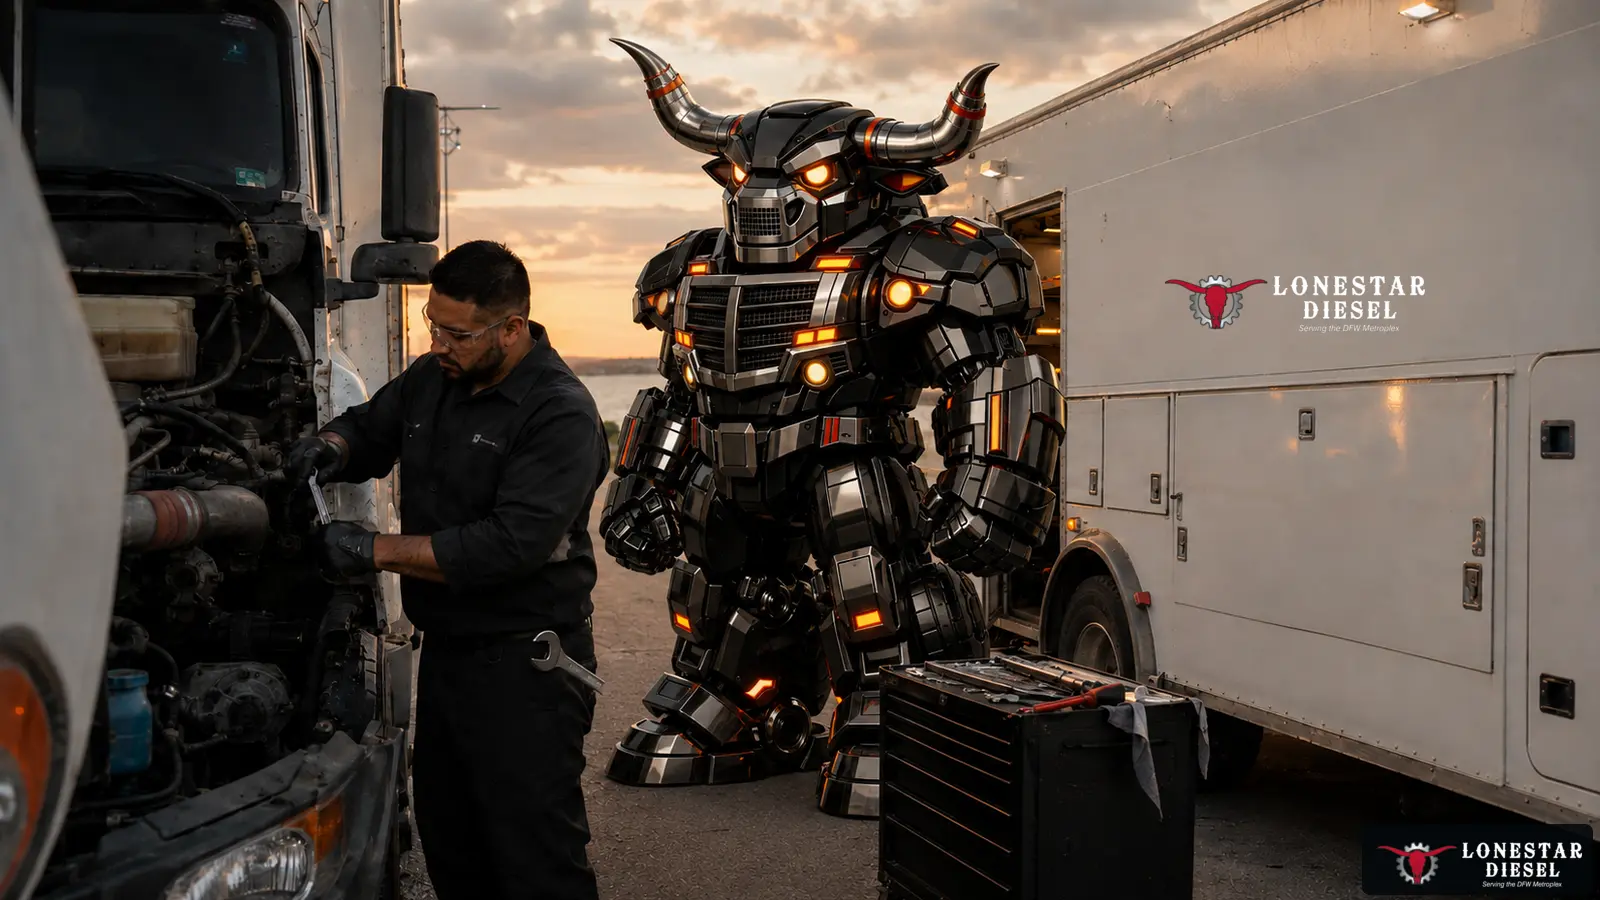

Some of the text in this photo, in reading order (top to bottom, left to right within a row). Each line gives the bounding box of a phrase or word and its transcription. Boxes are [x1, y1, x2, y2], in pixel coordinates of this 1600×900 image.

[1273, 275, 1426, 296] LONESTAR
[1303, 301, 1397, 319] DIESEL
[1298, 325, 1326, 333] Serving
[1342, 324, 1361, 332] DFW
[1363, 324, 1399, 333] Metroplex
